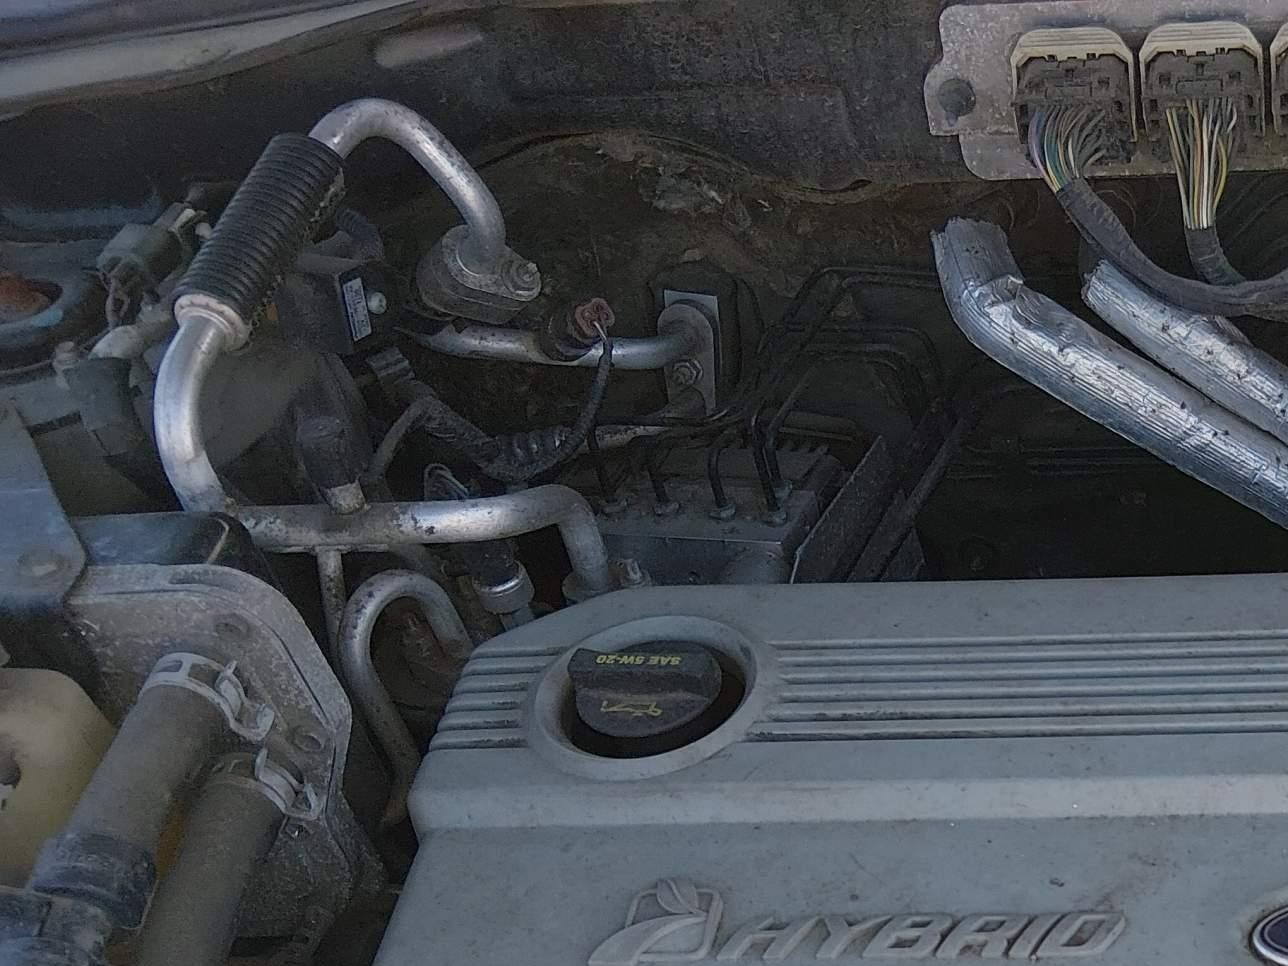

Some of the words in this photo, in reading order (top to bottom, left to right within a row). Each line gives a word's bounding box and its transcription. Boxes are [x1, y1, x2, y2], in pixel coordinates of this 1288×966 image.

[595, 654, 646, 665] 5W-20
[647, 655, 682, 666] SAE
[716, 910, 1127, 961] HYBRID
